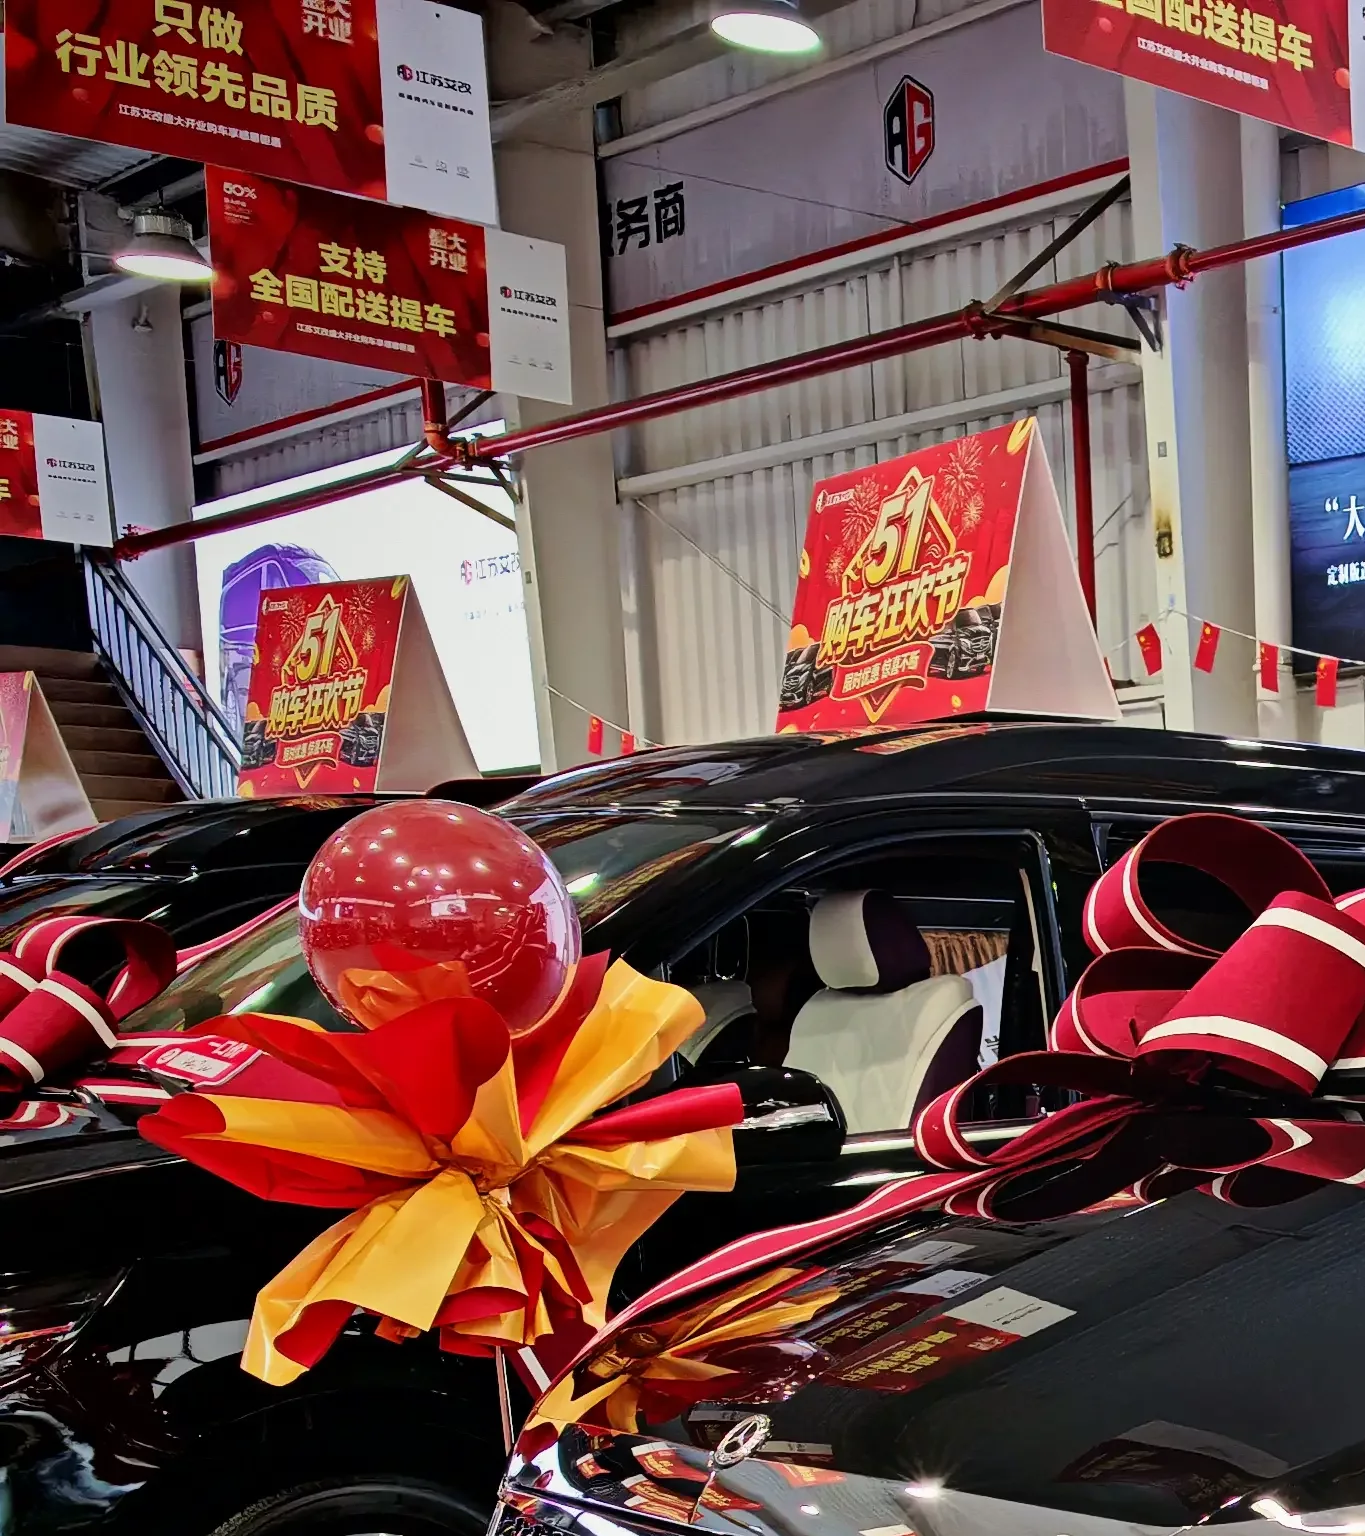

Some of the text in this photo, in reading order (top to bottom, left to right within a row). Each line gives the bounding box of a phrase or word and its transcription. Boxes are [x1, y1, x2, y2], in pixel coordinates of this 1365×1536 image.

[152, 0, 243, 56] 只做
[302, 10, 355, 46] 开业
[1096, 0, 1314, 72] 国配送提车
[55, 28, 338, 132] 行业领先品质
[318, 241, 387, 284] 支持
[428, 227, 467, 253] 盛大
[429, 249, 468, 274] 开业
[249, 267, 457, 338] 全国配送提车
[0, 419, 18, 435] 大
[864, 477, 932, 587] 51
[820, 557, 968, 658] 购车狂欢节
[296, 605, 342, 681] 51
[267, 673, 365, 733] 购车狂欢节
